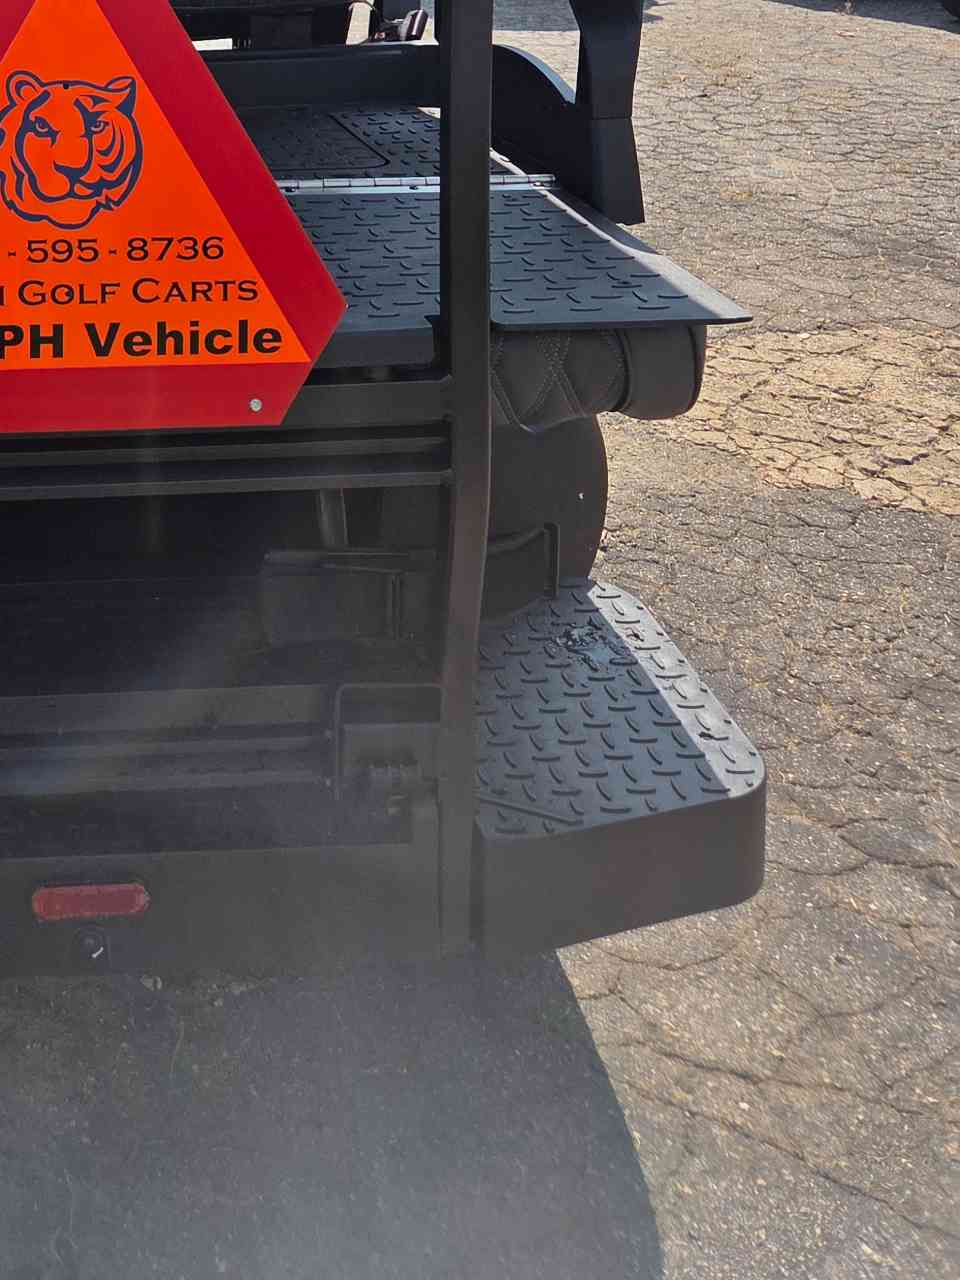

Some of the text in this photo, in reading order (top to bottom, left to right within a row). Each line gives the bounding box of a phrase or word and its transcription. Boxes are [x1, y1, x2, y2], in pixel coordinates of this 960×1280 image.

[18, 279, 121, 306] GOLF
[132, 277, 258, 304] CARTS
[84, 319, 282, 357] Vehicle
